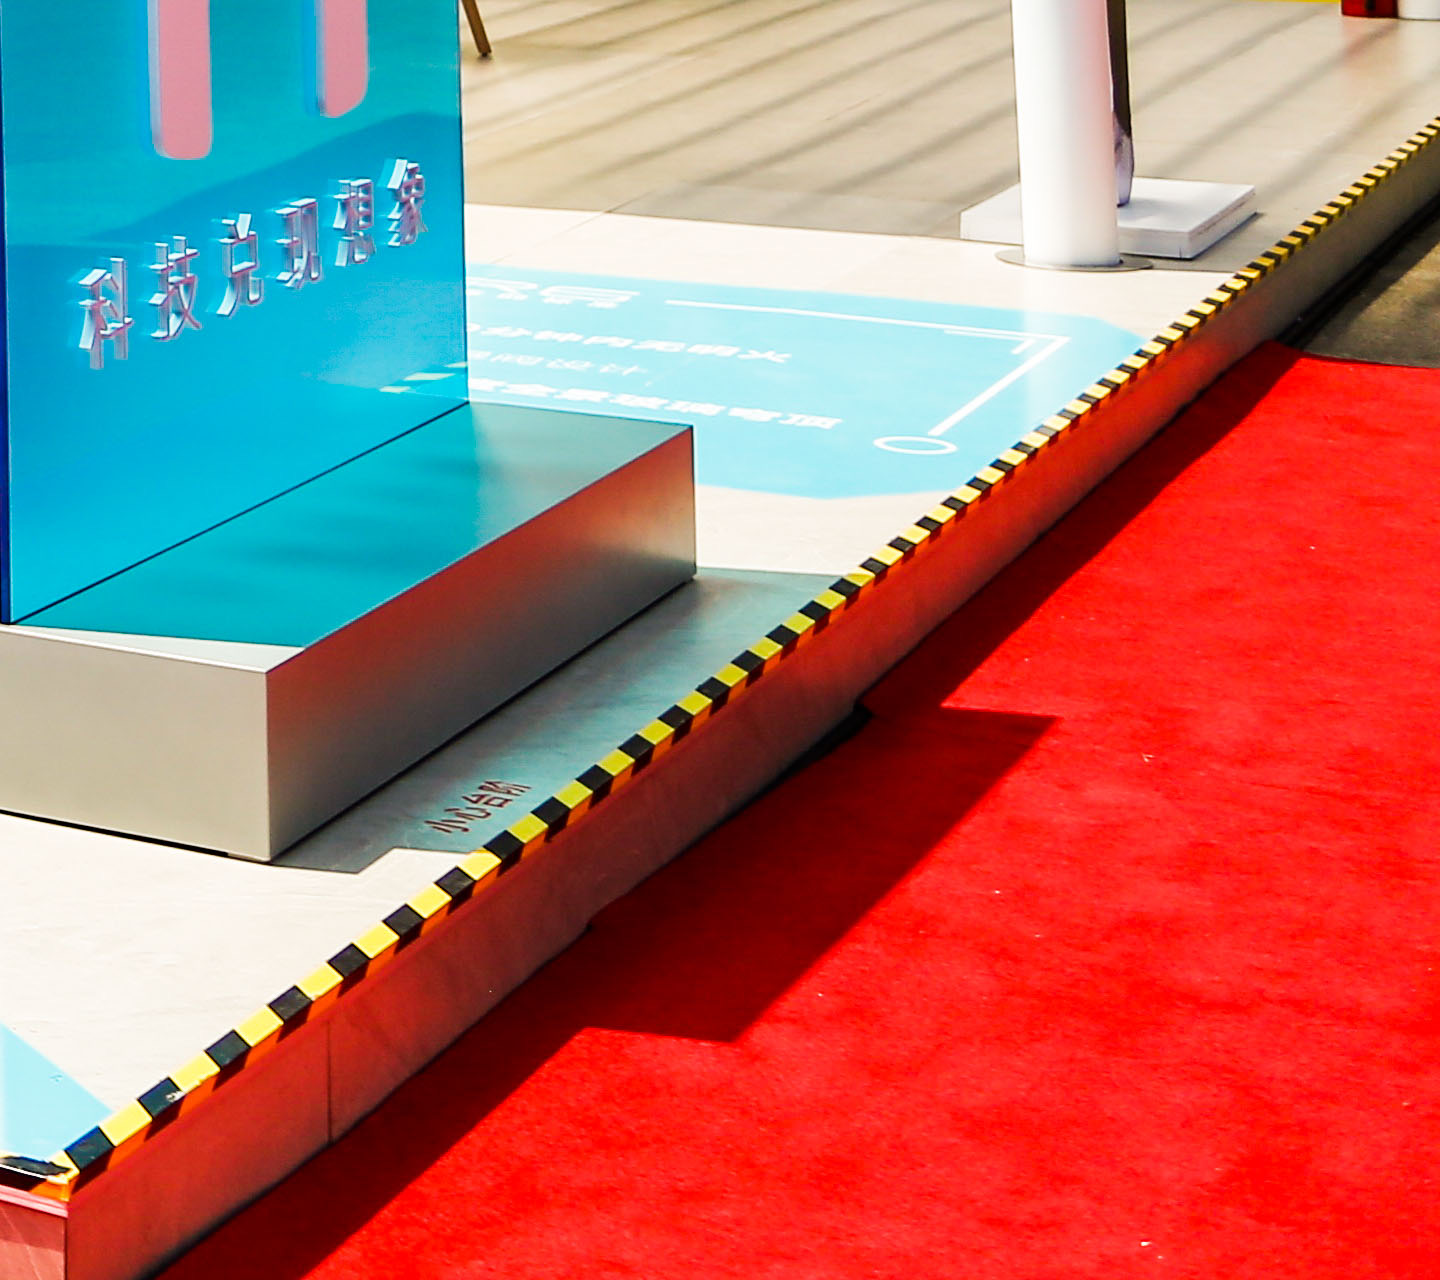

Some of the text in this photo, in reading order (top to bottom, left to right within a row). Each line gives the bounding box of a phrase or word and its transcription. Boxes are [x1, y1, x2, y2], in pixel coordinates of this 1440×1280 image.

[78, 159, 429, 370] 科技兑现想象
[423, 779, 533, 834] 小心台阶
